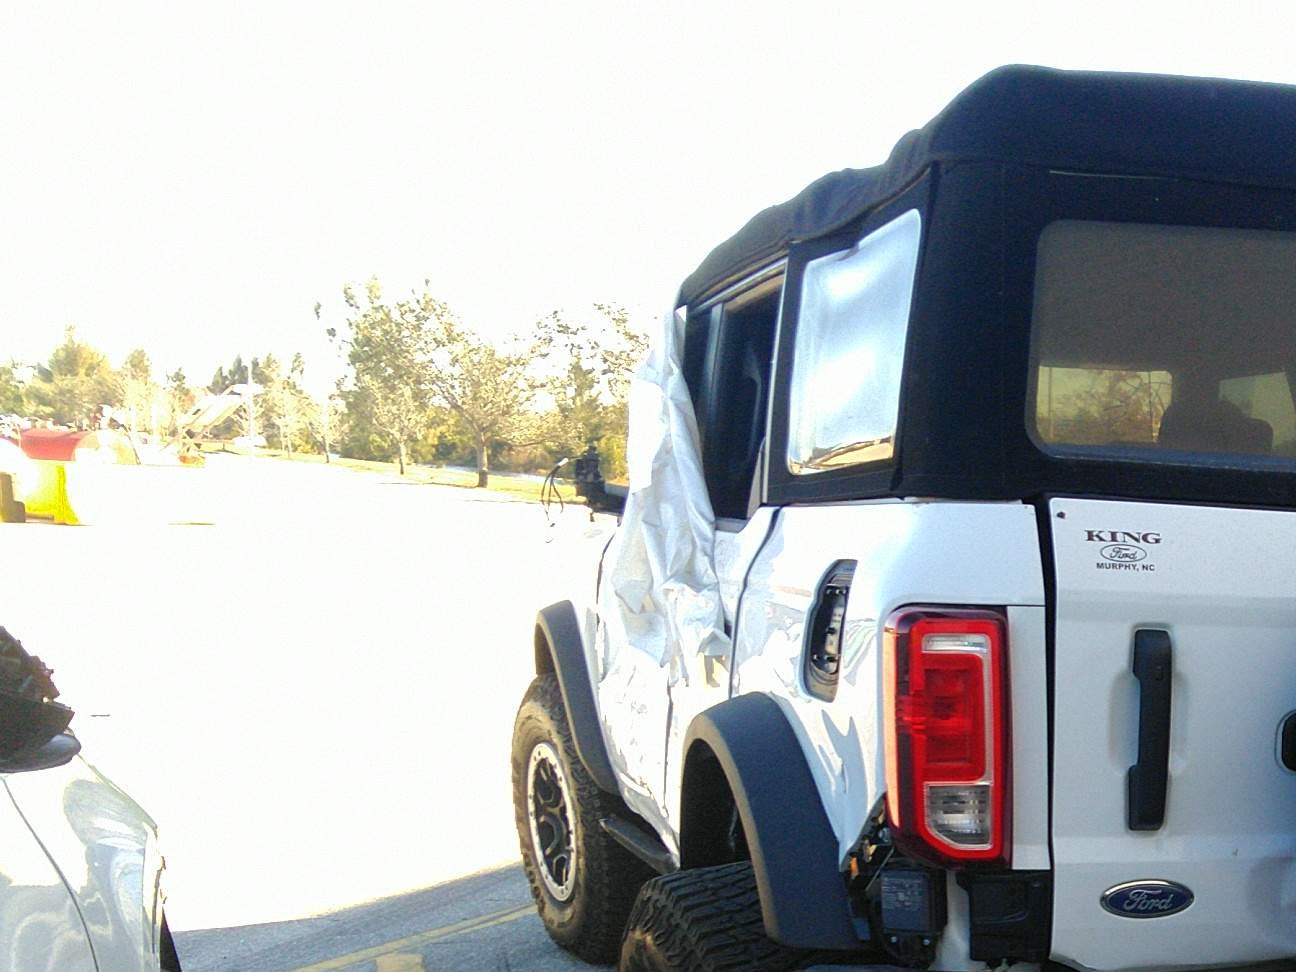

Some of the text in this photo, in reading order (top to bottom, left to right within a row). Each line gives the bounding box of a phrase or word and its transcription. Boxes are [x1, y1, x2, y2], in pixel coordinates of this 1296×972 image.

[1084, 530, 1162, 544] KING
[1109, 546, 1138, 560] Ford
[1096, 562, 1140, 572] MURPHY,
[1123, 889, 1174, 910] Ford
